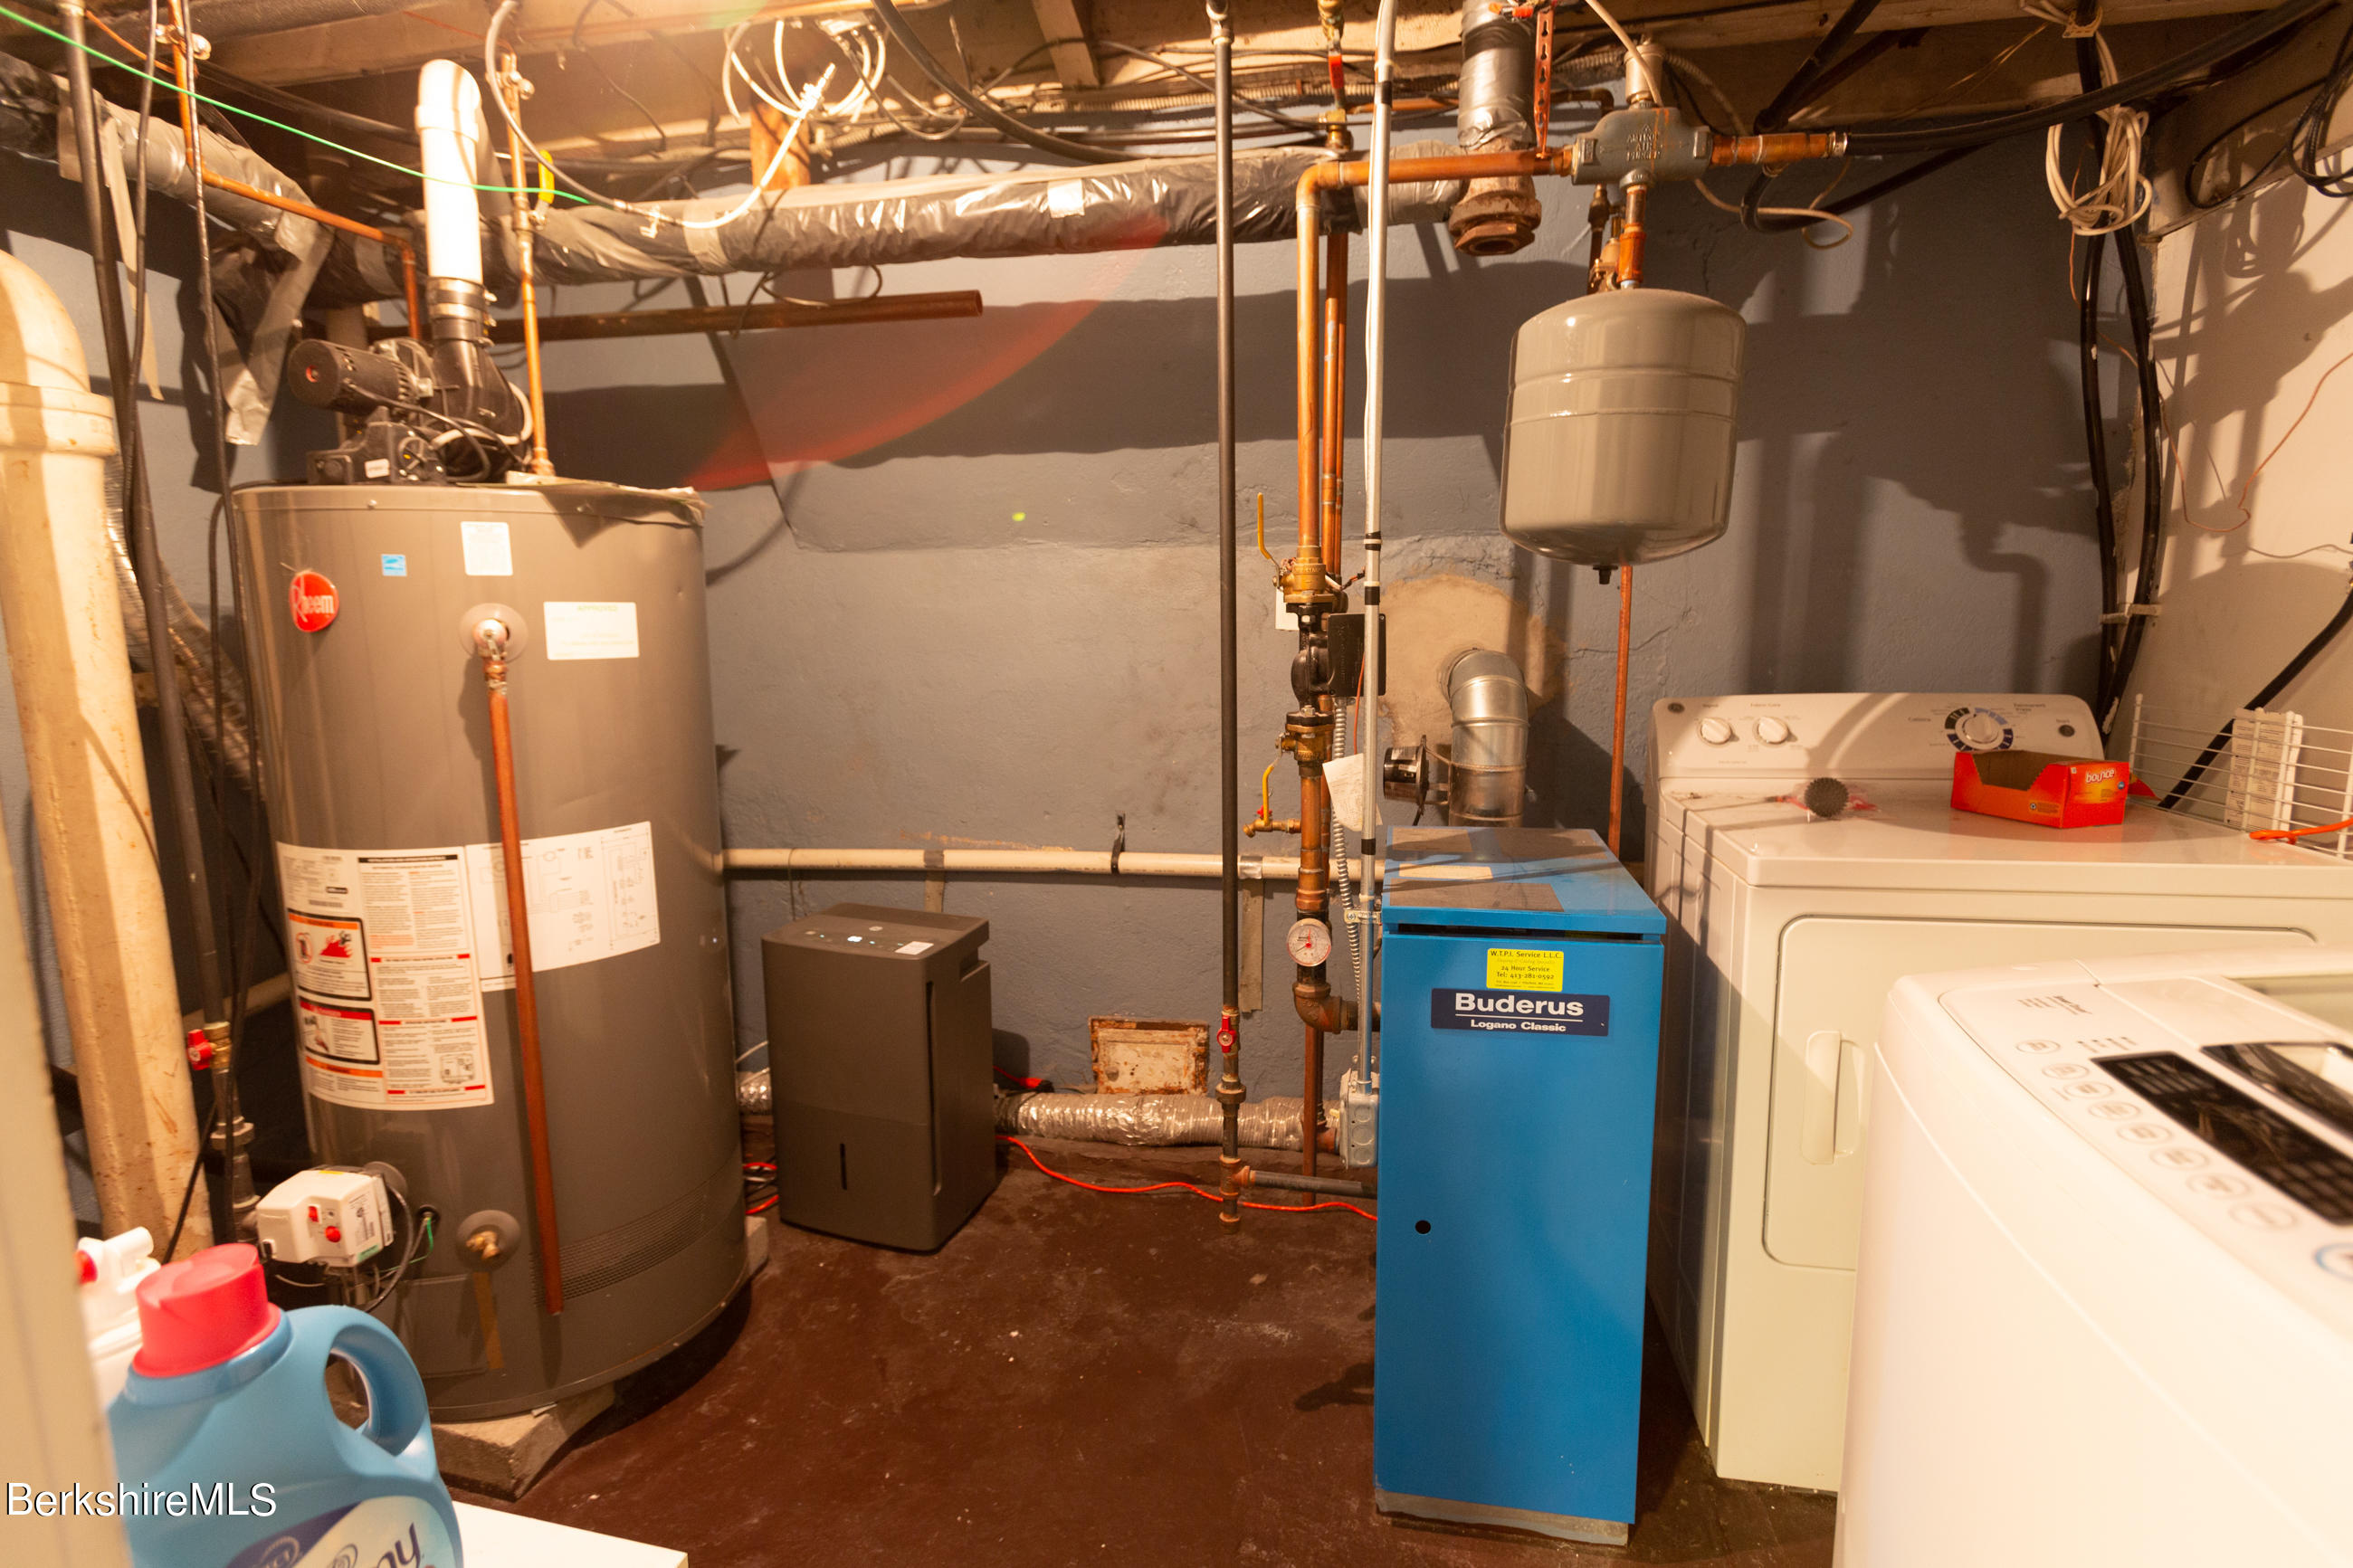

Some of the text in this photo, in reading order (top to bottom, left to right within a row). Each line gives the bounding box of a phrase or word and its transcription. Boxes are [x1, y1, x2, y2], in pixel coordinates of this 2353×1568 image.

[291, 574, 334, 622] Rheem
[2085, 768, 2115, 784] bounce
[1455, 993, 1584, 1016] Buderus
[1471, 1019, 1567, 1031] Logano Classic
